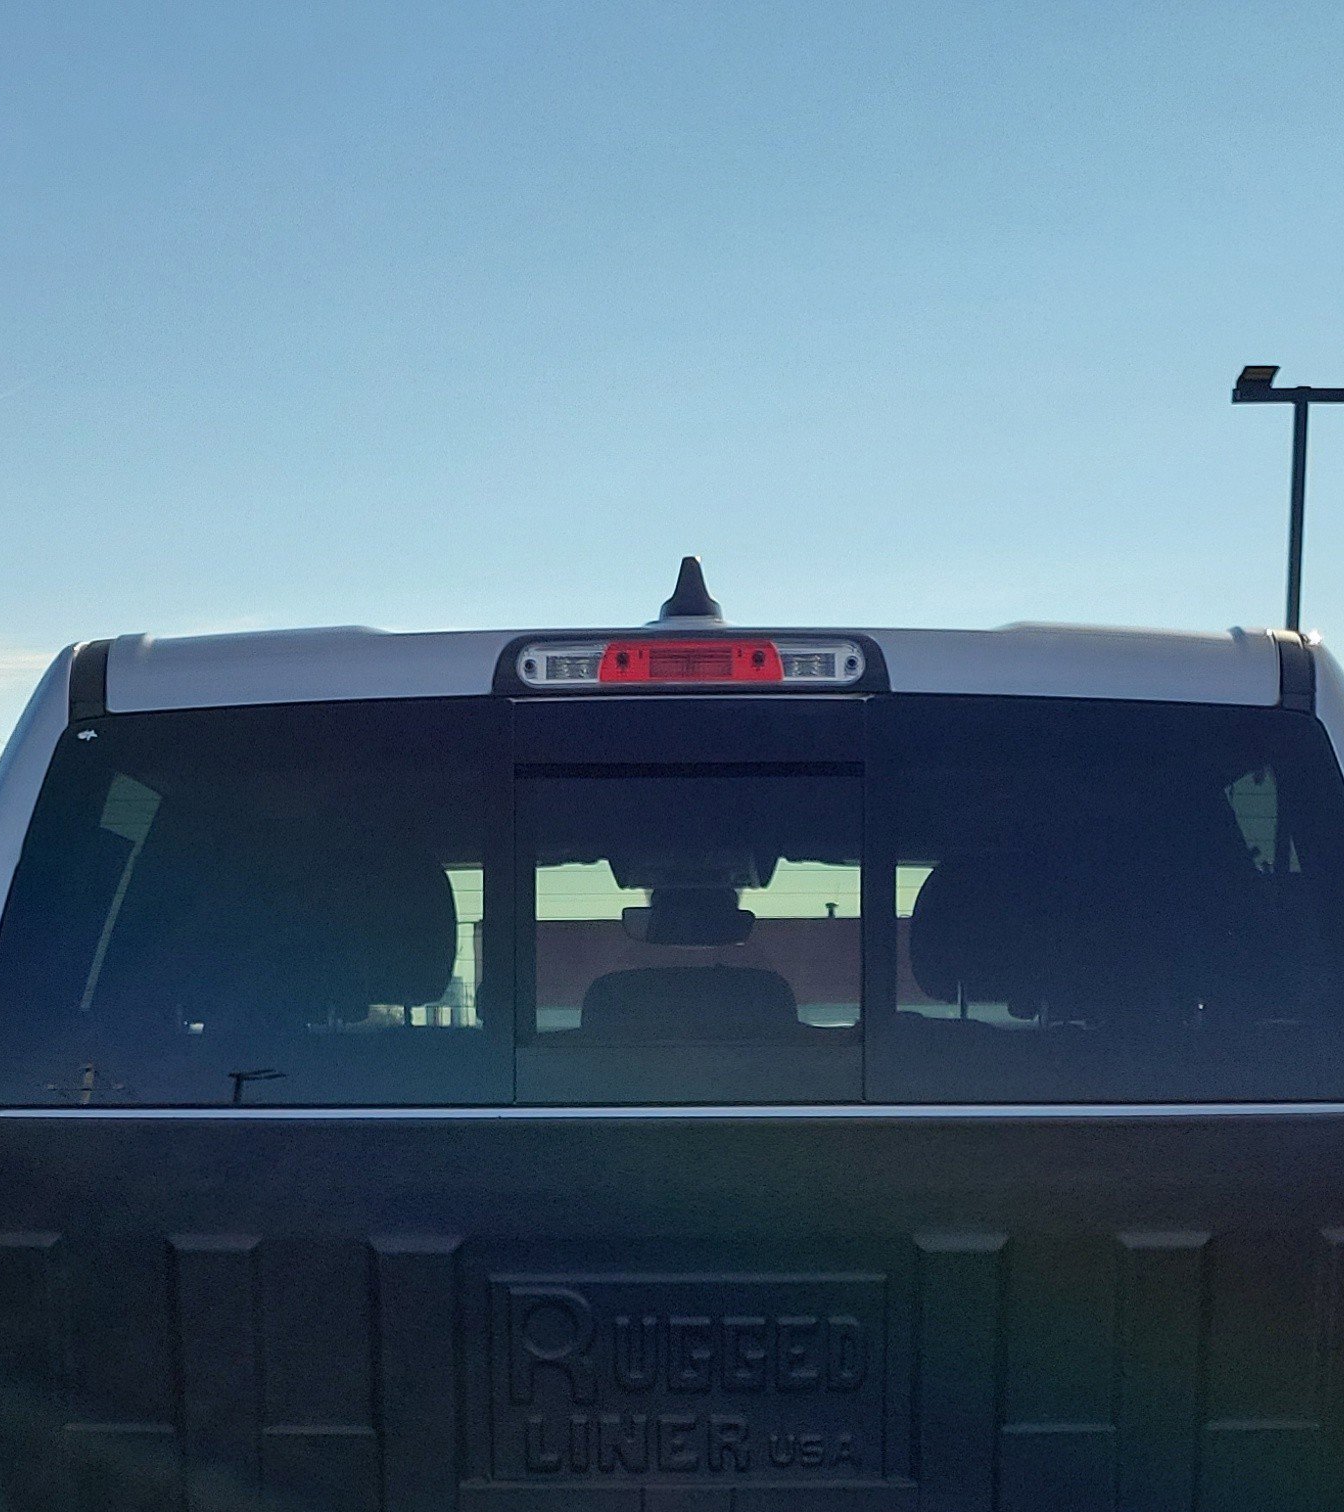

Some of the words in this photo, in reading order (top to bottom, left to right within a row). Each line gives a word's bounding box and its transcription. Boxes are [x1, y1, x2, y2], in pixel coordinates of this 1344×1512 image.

[508, 1285, 870, 1406] RUGGED
[523, 1413, 753, 1475] LINER
[768, 1432, 863, 1470] USA
